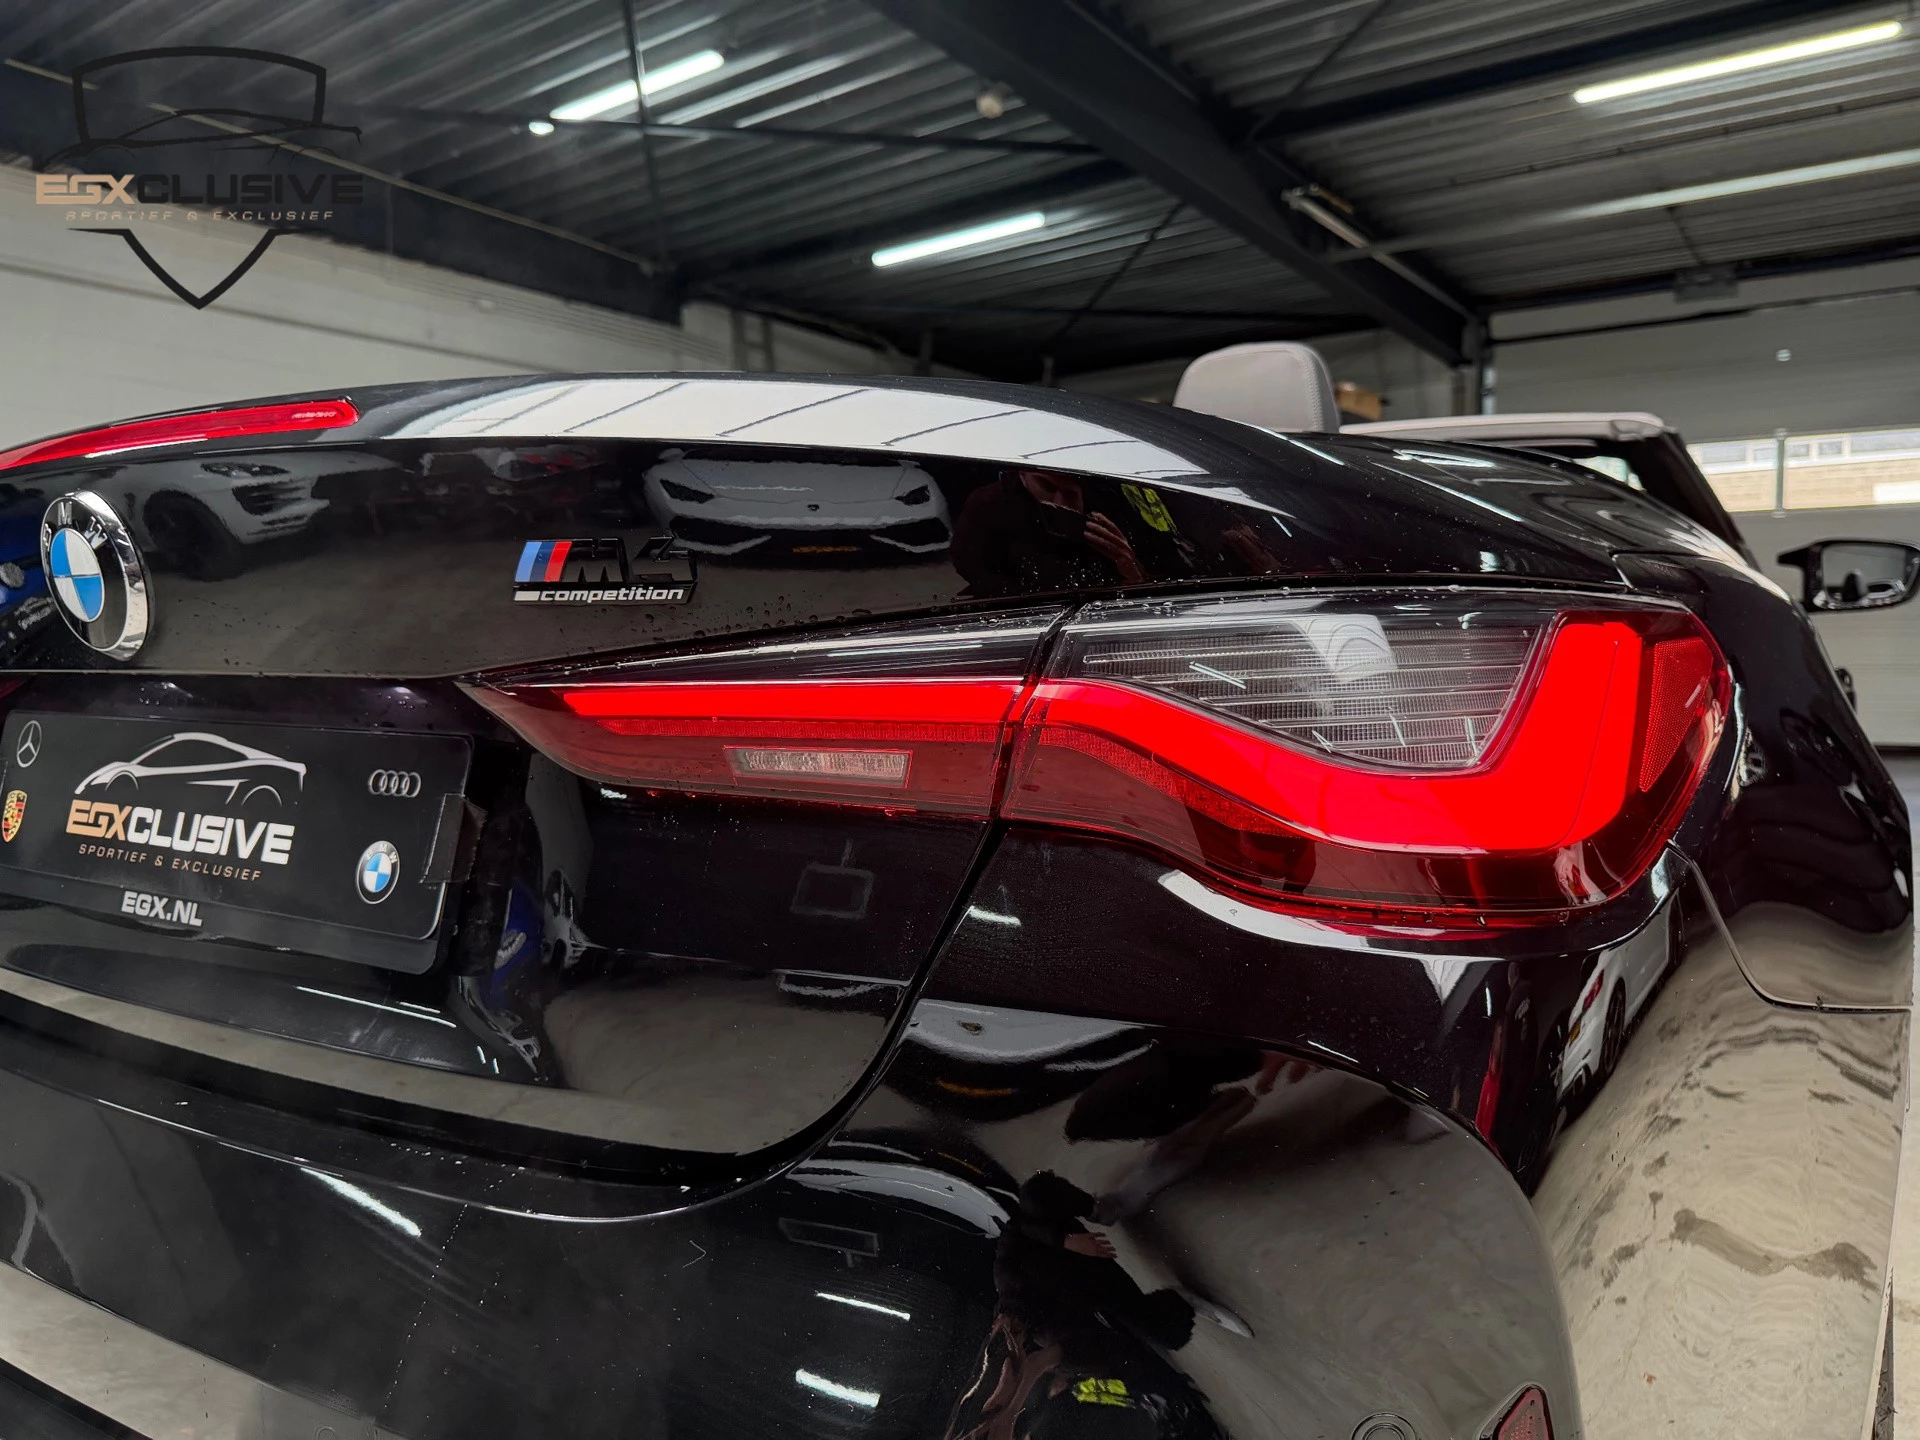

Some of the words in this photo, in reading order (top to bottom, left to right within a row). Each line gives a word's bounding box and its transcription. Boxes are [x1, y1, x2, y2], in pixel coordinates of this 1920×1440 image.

[43, 500, 108, 551] BMW
[540, 586, 684, 603] competition
[65, 799, 295, 865] EGXCLUSIVE
[78, 844, 147, 863] SPORTIEF
[154, 855, 164, 867] &
[171, 858, 262, 882] EXCLUSIEF
[121, 890, 203, 927] EGX.NL
